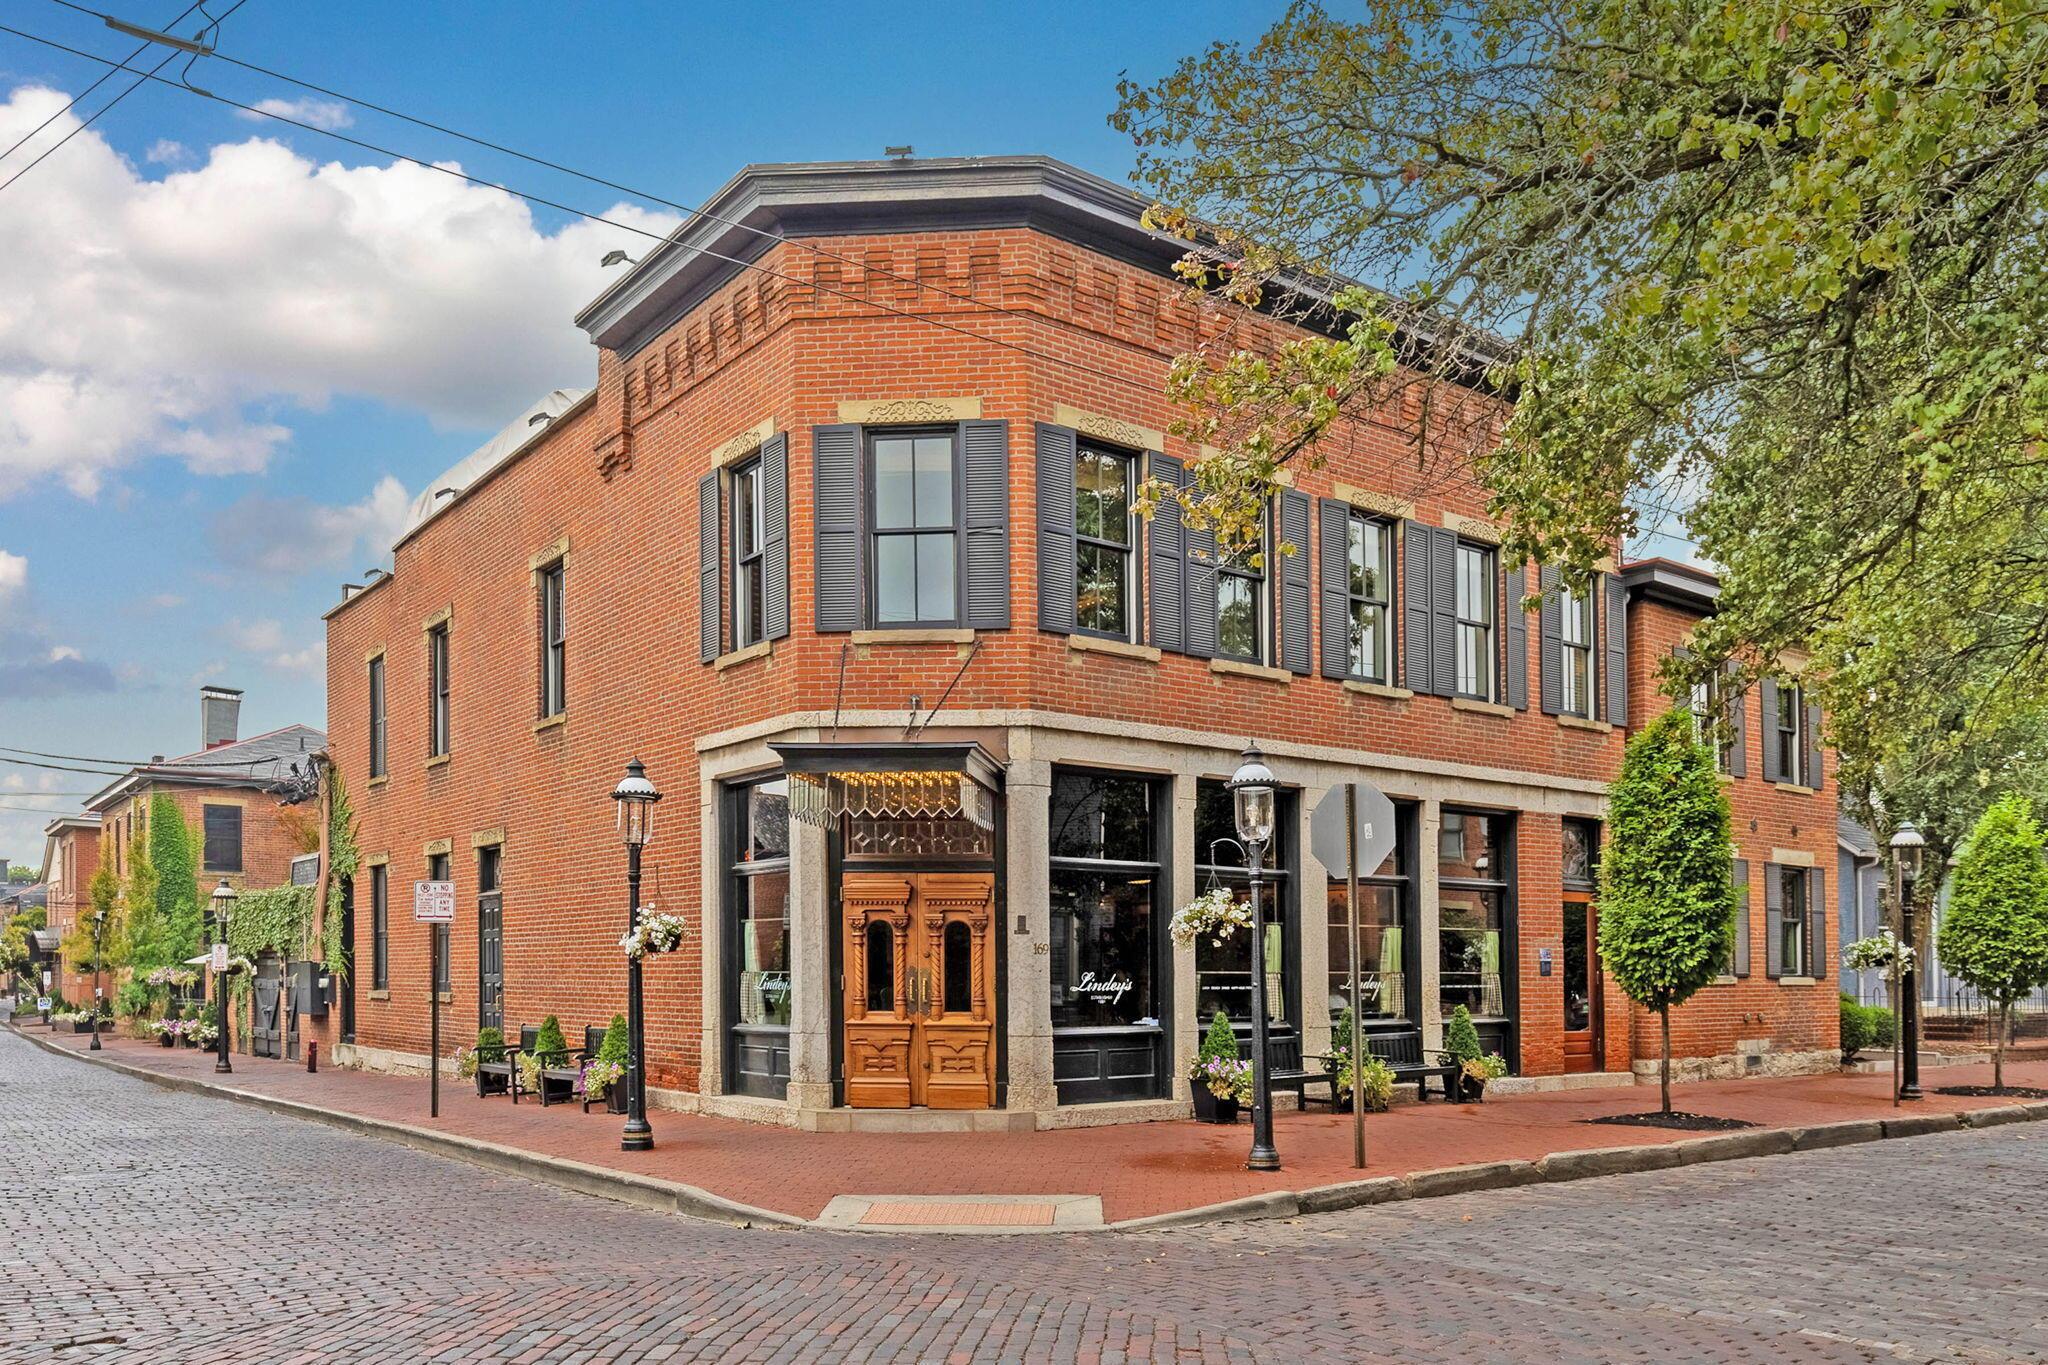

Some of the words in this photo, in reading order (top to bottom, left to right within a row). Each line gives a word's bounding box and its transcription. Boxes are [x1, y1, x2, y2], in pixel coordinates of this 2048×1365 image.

[440, 884, 449, 892] NO
[1033, 943, 1049, 955] 169
[1069, 971, 1133, 1005] Lindey's
